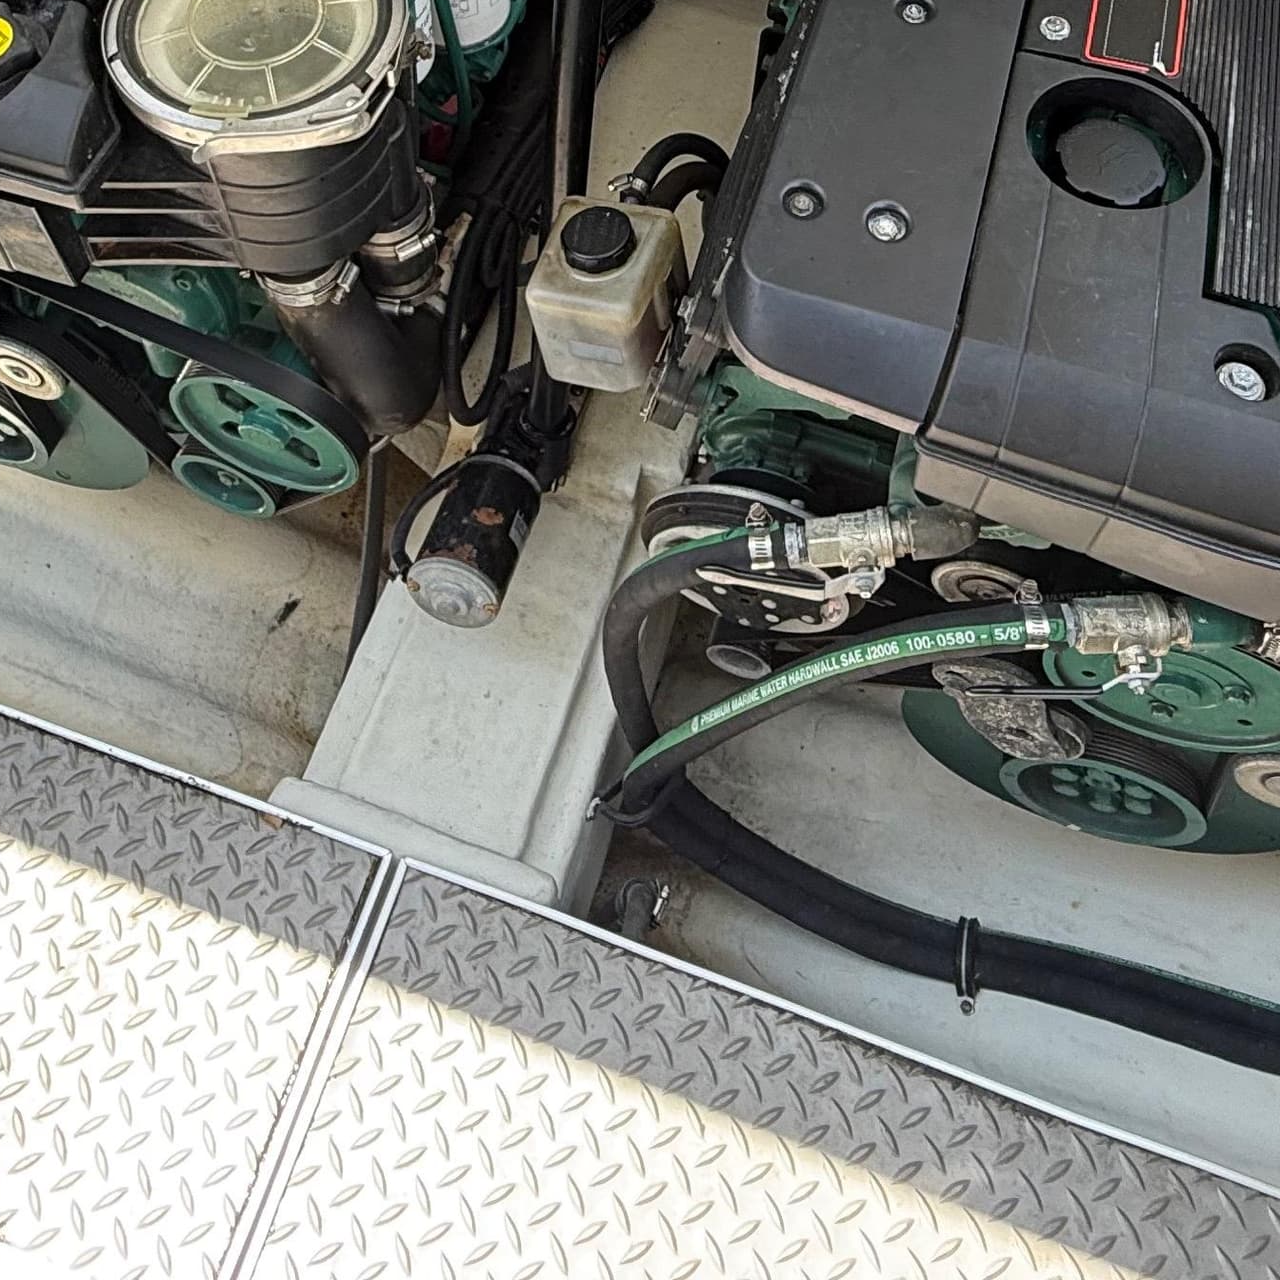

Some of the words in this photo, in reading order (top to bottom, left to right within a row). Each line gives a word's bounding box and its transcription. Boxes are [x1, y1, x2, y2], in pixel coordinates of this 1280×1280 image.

[700, 701, 731, 726] PREMIUM
[731, 689, 760, 712] MARINE
[760, 677, 788, 698] WATER
[788, 660, 840, 686] HARDWALL
[840, 651, 864, 668] SAE
[865, 642, 900, 661] J2006
